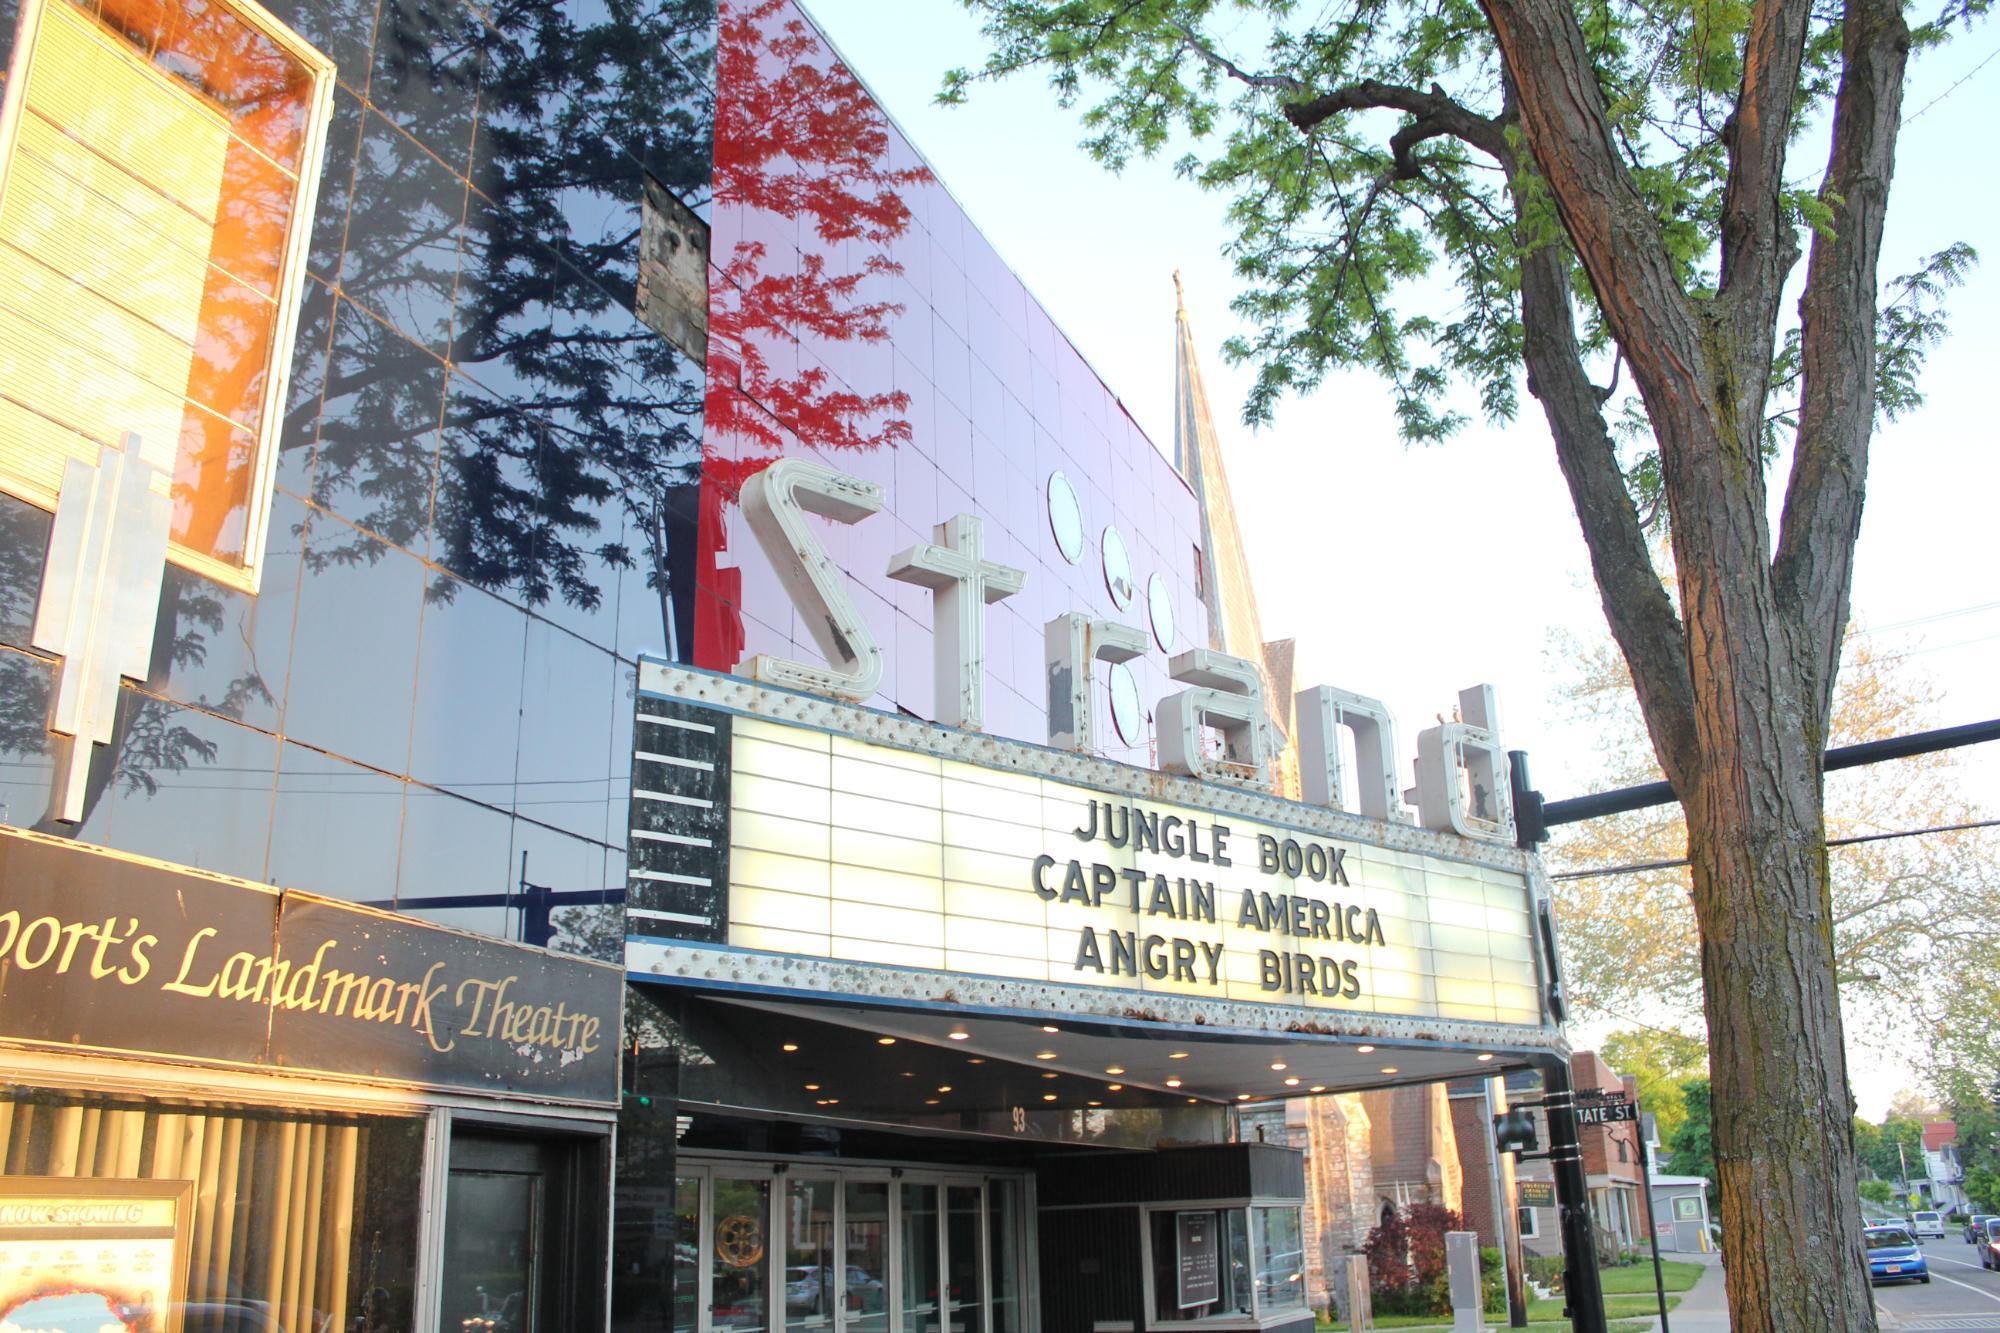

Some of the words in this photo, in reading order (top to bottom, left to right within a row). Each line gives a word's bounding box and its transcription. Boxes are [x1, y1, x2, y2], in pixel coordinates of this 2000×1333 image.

[732, 457, 1516, 840] Strand
[1073, 799, 1232, 868] JUNGLE
[1257, 833, 1350, 887] BOOK
[1031, 854, 1216, 924] CAPTAIN
[1237, 888, 1386, 947] AMERICA
[160, 927, 455, 1052] Landmark
[455, 975, 600, 1053] Theatre
[1074, 926, 1224, 986] ANGRY
[1259, 949, 1361, 1000] BIRDS
[1012, 1106, 1025, 1132] 93
[1577, 1107, 1608, 1123] TATE
[1615, 1105, 1632, 1119] ST
[0, 1204, 51, 1224] NOW
[54, 1203, 143, 1224] SHOWING
